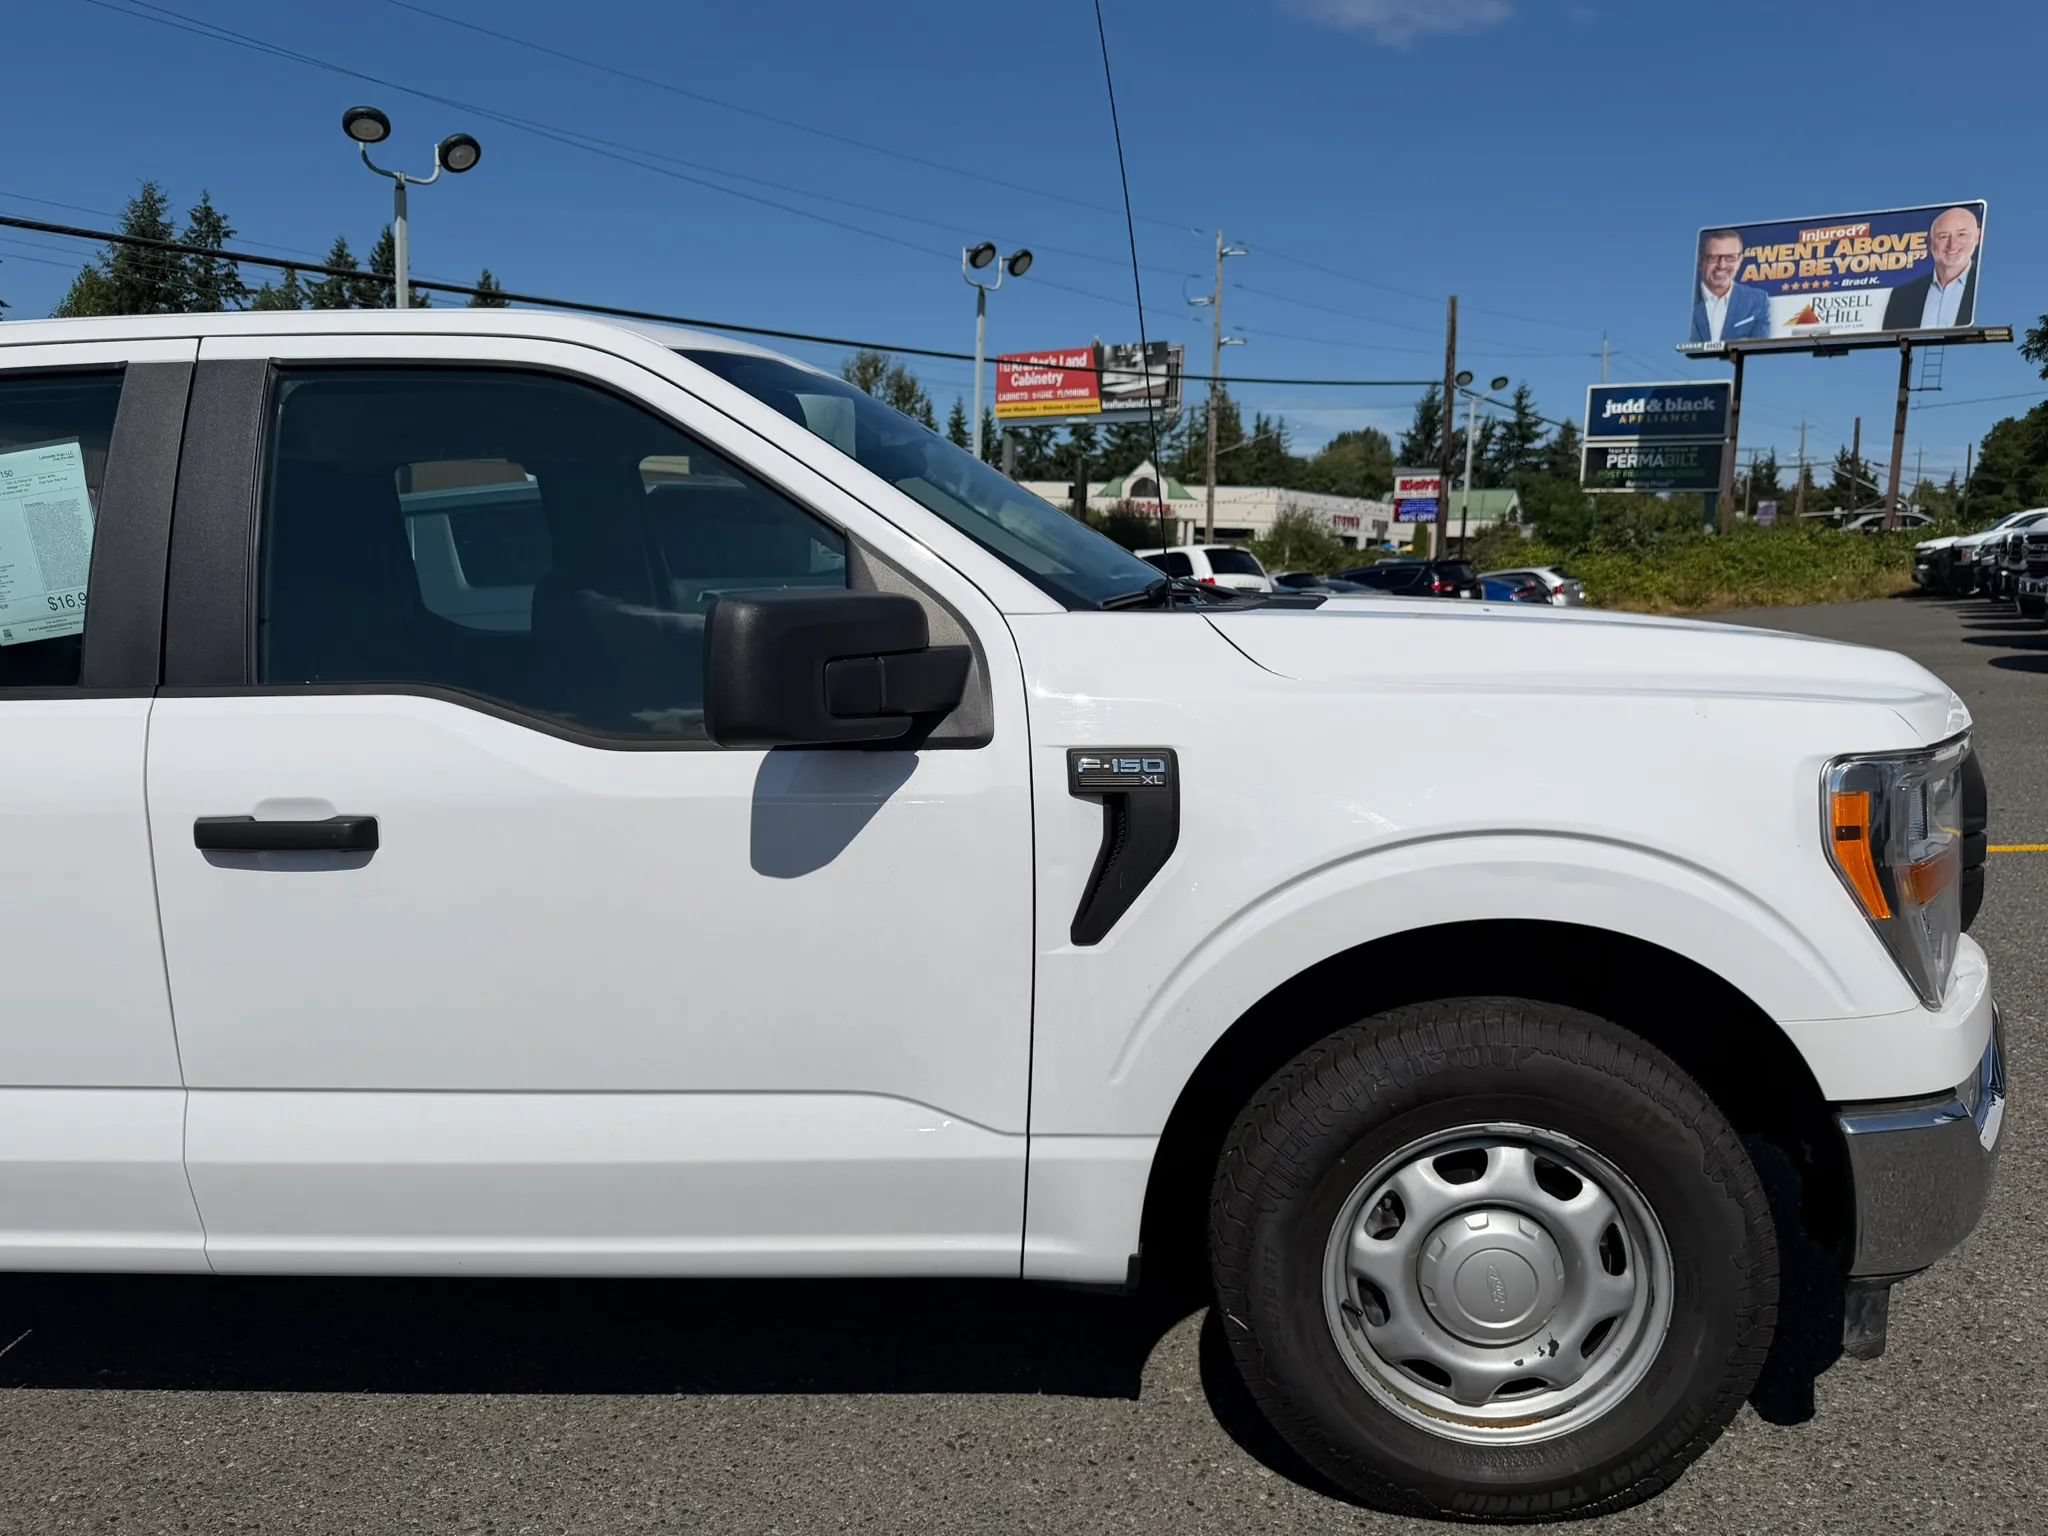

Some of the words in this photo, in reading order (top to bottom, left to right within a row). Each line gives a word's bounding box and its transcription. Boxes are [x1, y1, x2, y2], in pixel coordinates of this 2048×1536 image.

[1801, 225, 1866, 243] Injured?
[1833, 232, 1928, 257] ABOVE
[1740, 263, 1796, 282] AND
[1841, 277, 1867, 287] Brad
[1869, 276, 1880, 285] K.
[1811, 295, 1872, 312] RUSSELL
[1059, 352, 1087, 368] Land
[1011, 371, 1064, 388] Cabinetry
[1602, 398, 1645, 418] judd
[1646, 399, 1662, 413] &
[1665, 396, 1715, 412] black
[1618, 413, 1697, 425] APPLIANCE
[1606, 453, 1699, 469] PERMABILT
[1077, 758, 1165, 773] F-150
[1141, 775, 1164, 785] XL
